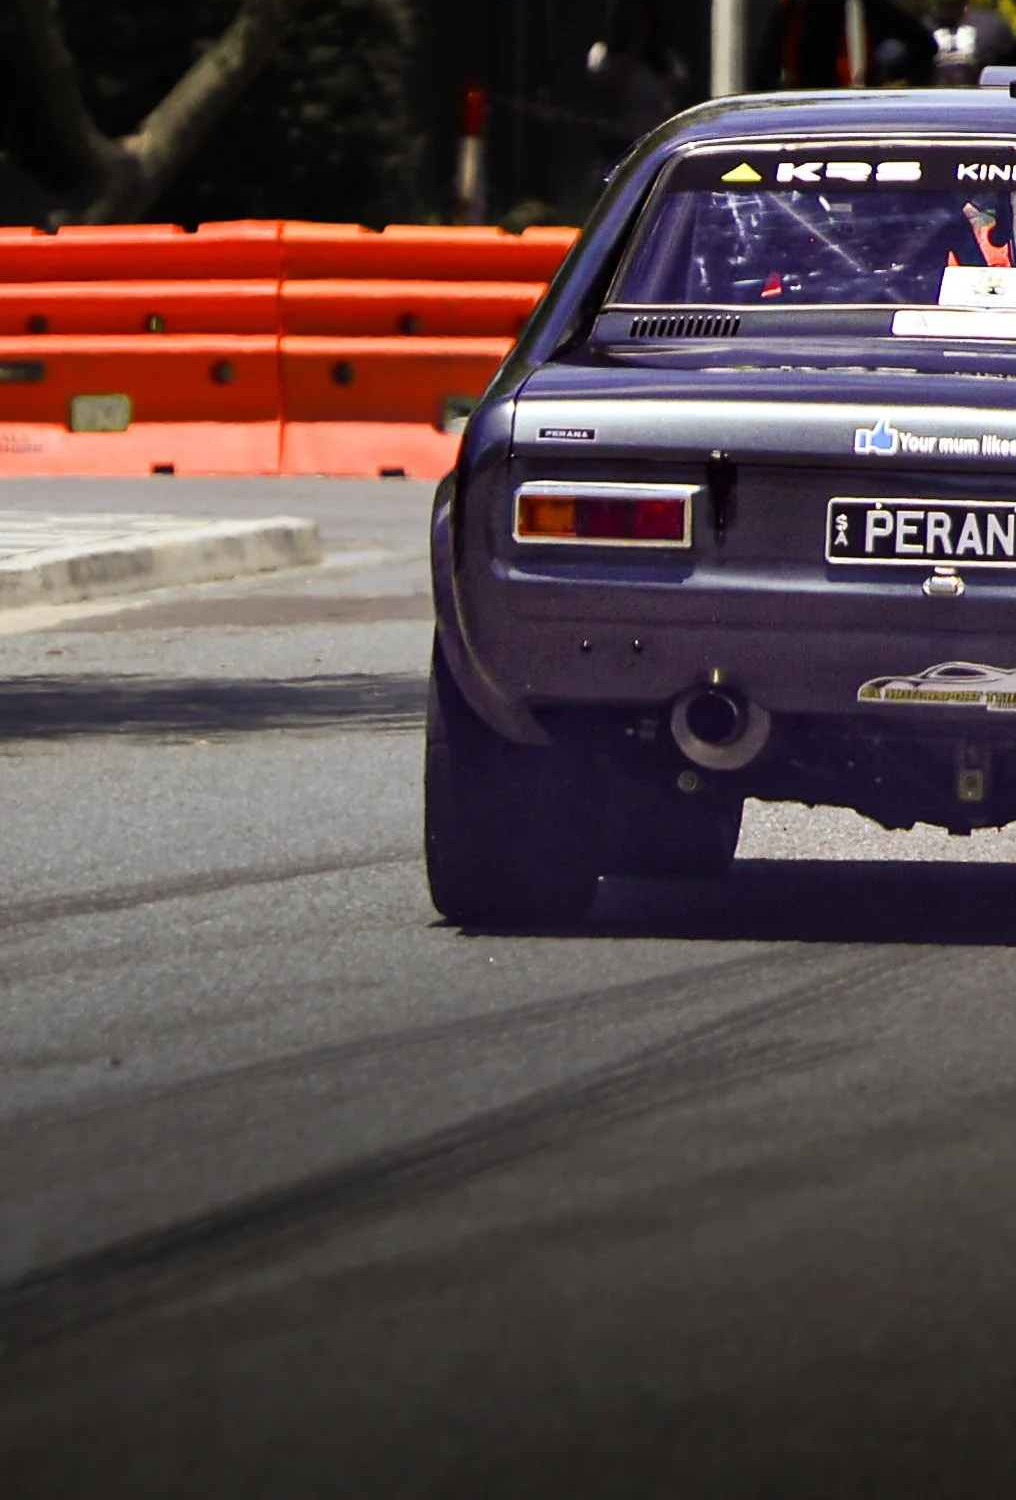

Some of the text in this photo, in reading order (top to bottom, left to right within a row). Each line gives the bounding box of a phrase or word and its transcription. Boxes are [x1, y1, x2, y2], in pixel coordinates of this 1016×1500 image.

[776, 161, 922, 182] KRS
[545, 430, 589, 438] PERANA
[899, 431, 938, 453] Your
[939, 436, 980, 455] mum
